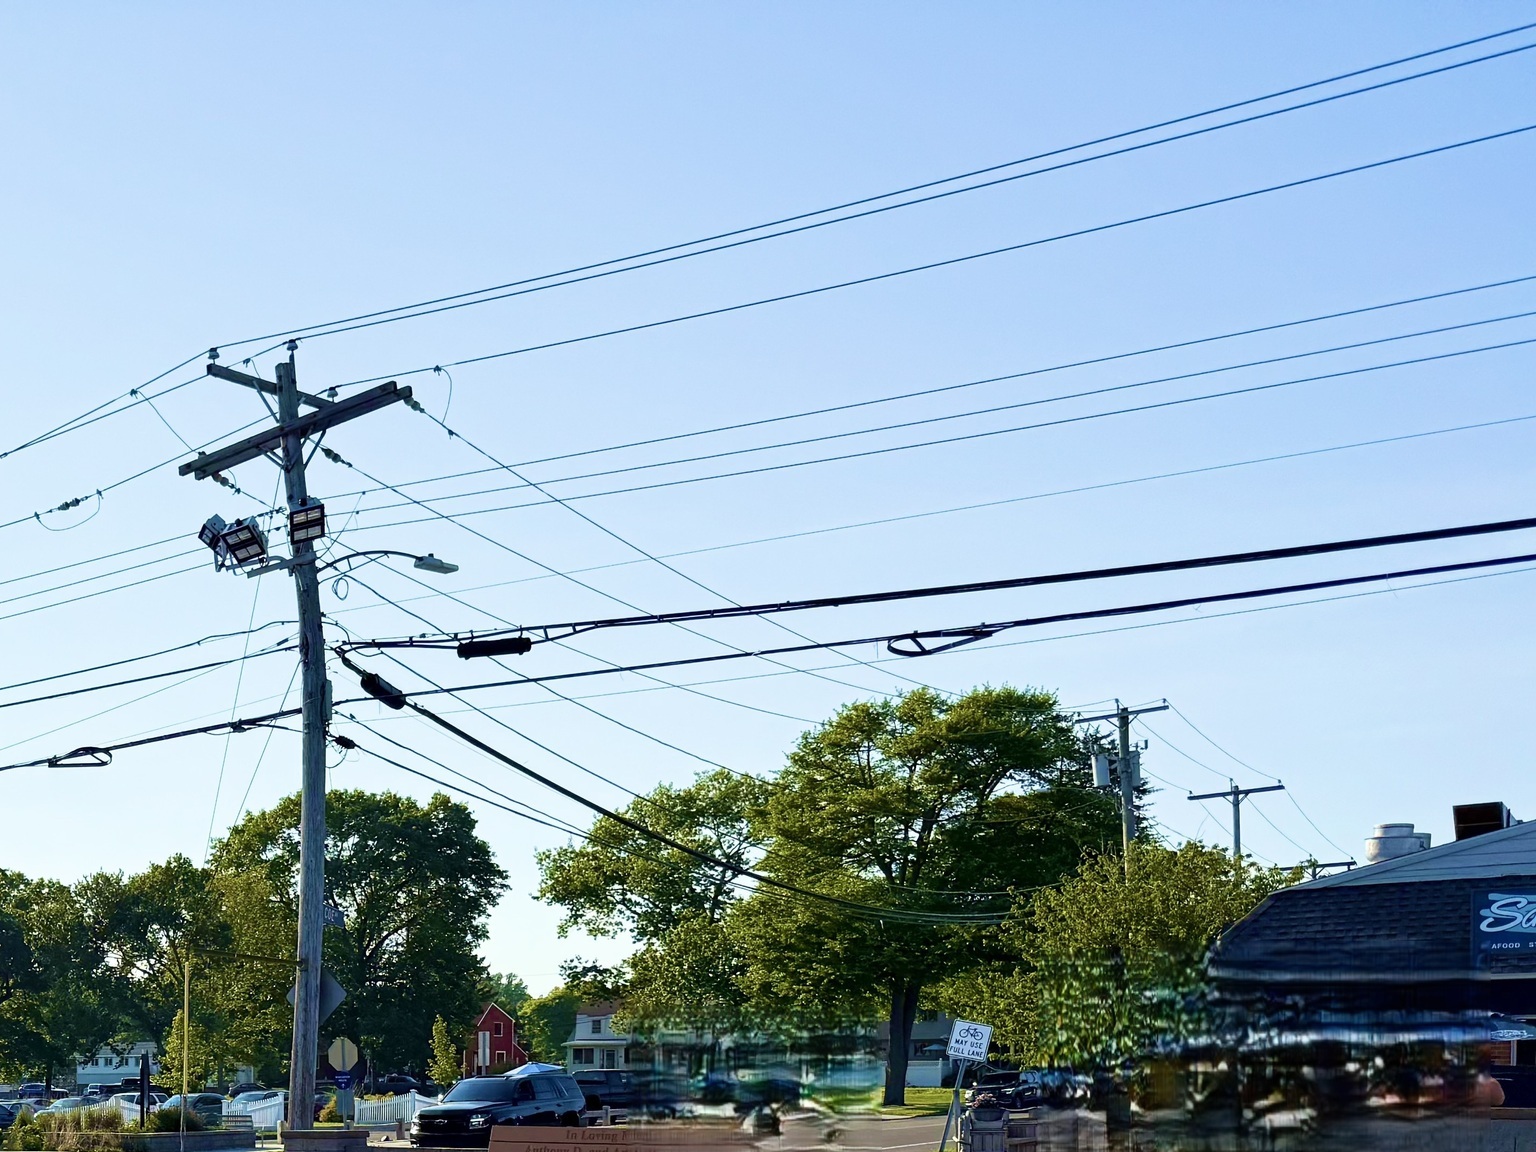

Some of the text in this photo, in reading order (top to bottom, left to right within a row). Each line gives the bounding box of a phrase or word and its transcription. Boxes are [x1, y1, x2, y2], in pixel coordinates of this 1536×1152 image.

[955, 1038, 983, 1049] MAY USE
[950, 1045, 984, 1058] FULL LANE
[565, 1129, 577, 1140] In
[581, 1130, 618, 1143] Loving
